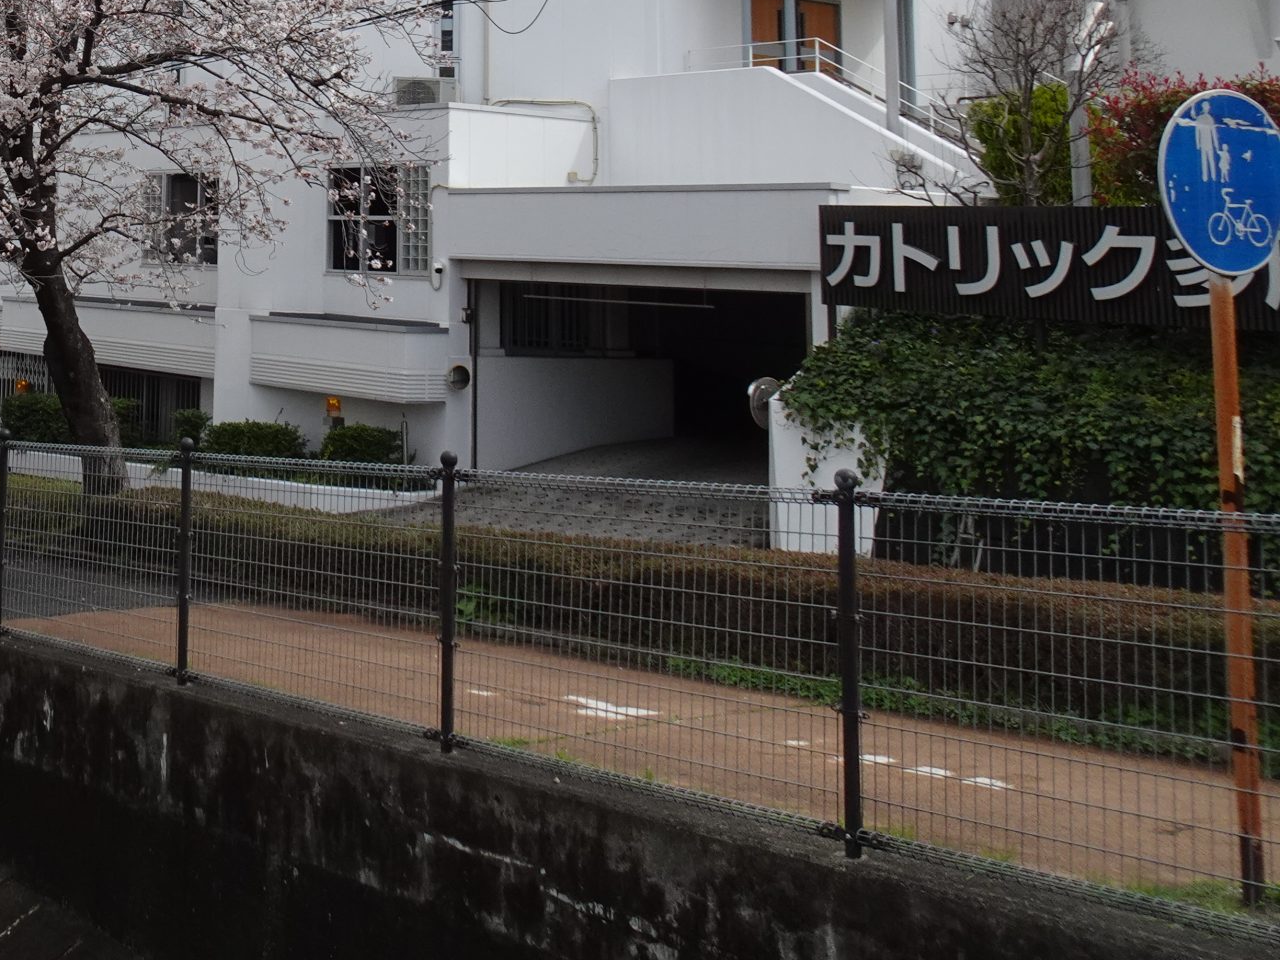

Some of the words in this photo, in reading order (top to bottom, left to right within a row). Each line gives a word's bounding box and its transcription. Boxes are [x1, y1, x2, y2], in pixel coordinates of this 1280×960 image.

[825, 221, 1280, 310] カトリック
